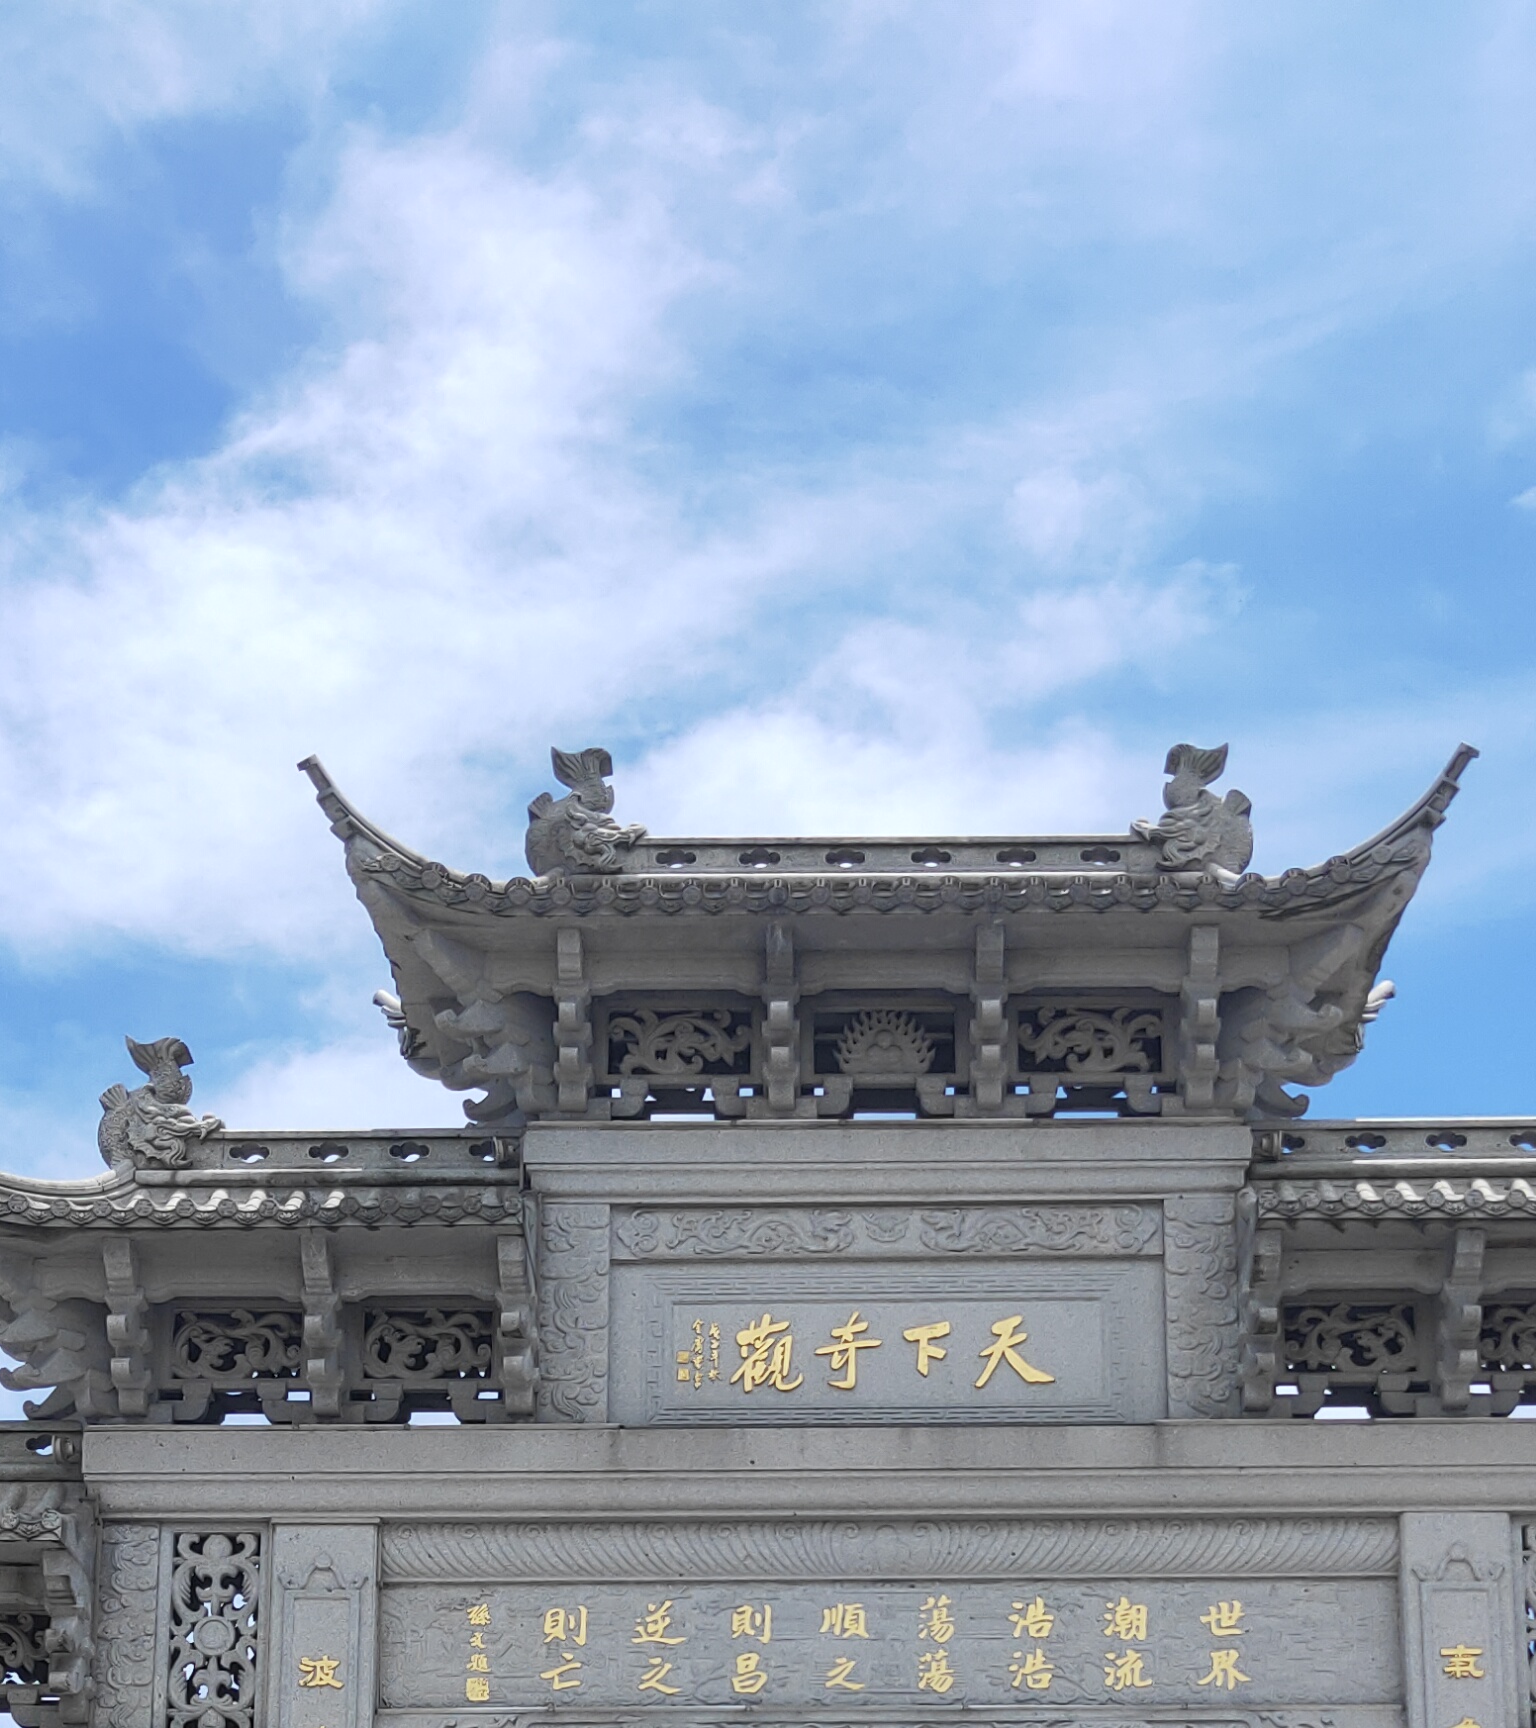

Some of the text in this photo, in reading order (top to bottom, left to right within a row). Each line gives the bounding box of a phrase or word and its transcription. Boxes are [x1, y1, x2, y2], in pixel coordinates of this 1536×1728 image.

[730, 1311, 1056, 1393] 天下奇觀
[540, 1605, 588, 1691] 則亡
[631, 1600, 686, 1695] 逆之
[730, 1604, 772, 1695] 則昌
[819, 1603, 869, 1691] 順之
[918, 1595, 955, 1694] 蕩蕩
[1008, 1597, 1054, 1690] 浩浩
[1103, 1597, 1152, 1691] 潮流
[1199, 1600, 1251, 1691] 世界
